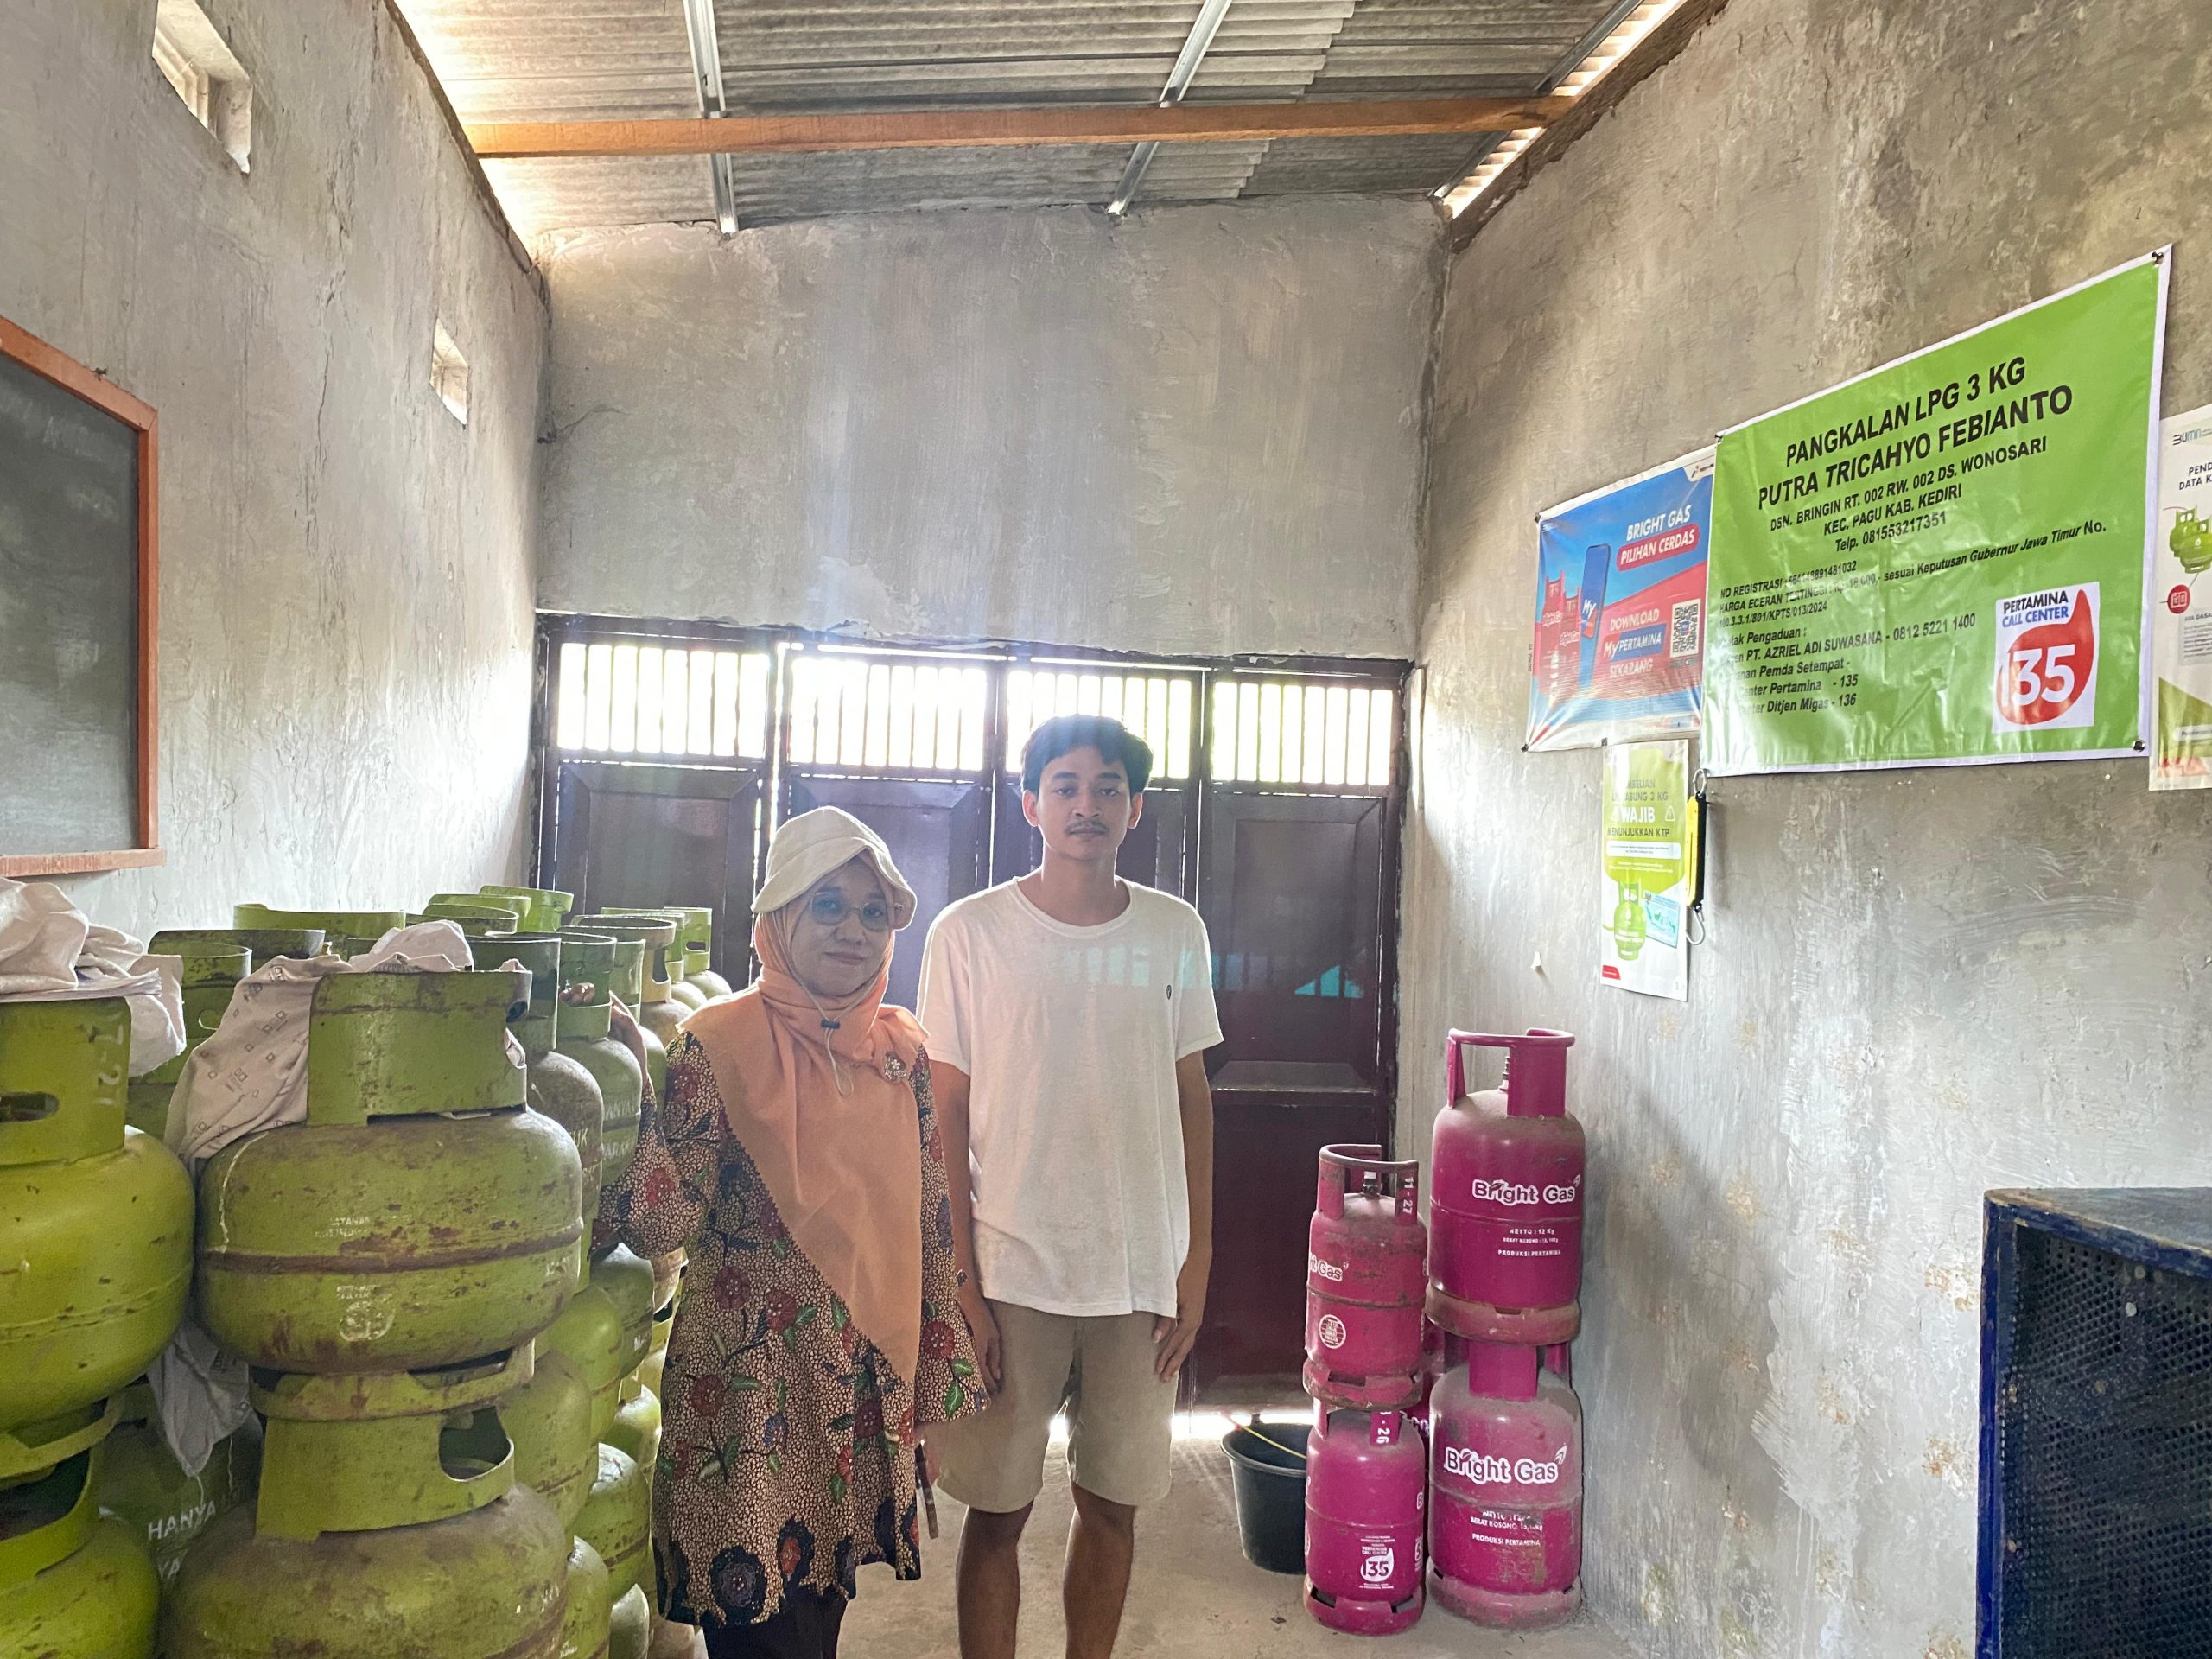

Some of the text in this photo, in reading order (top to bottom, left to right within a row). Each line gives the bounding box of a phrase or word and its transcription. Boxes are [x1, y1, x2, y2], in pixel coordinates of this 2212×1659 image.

[1787, 357, 2025, 467] PANGKALAN LPG 3 KG
[1758, 385, 2072, 510] PUTRA TRICAHYO FEBIANTO
[1770, 436, 2047, 531] DSN. BRINGIN RT. 002 RW. 002 DS. WONOSARI
[2179, 477, 2202, 490] DATA
[1824, 484, 1962, 536] KEC. PAGU KAB. KEDIRI
[1626, 505, 1692, 542] BRIGHT GAS
[1620, 528, 1695, 565] PILIHAN CERDAS
[1835, 537, 1859, 552] Telp.
[1748, 594, 1783, 608] ECERAN
[1884, 568, 1915, 582] sesuai
[1917, 555, 1967, 576] Keputusan
[1969, 543, 2019, 562] Gubernur
[2020, 536, 2048, 550] Jawa
[2051, 526, 2082, 543] Timur
[2083, 520, 2106, 535] No.
[1720, 588, 1731, 599] NO
[1733, 578, 1783, 596] REGISTRASI
[2003, 590, 2069, 615] PERTAMINA
[1610, 608, 1660, 632] DOWNLOAD
[2002, 606, 2069, 628] CALL CENTER
[1746, 627, 1801, 645] Pengaduan
[1746, 649, 1761, 661] PT.
[1764, 645, 1801, 659] AZRIEL
[1804, 641, 1821, 655] ADI
[1824, 631, 1883, 652] SUWASANA
[1893, 625, 1919, 641] 0812
[1923, 619, 1948, 636] 5221
[1952, 613, 1975, 631] 1400
[1759, 663, 1794, 677] Pemda
[1796, 657, 1844, 675] Setempat
[2000, 644, 2075, 707] 135
[1770, 679, 1821, 694] Pertamina
[1840, 674, 1859, 688] 135
[1767, 700, 1796, 715] Ditjen
[1800, 697, 1829, 713] Migas
[1838, 693, 1857, 708] 136
[1623, 792, 1648, 801] ABUNG
[1657, 792, 1669, 801] KG
[1621, 806, 1656, 823] WAJIB
[1656, 829, 1669, 837] KTP
[1472, 1179, 1575, 1206] Bright Gas
[1318, 1260, 1343, 1281] Gas
[1445, 1446, 1558, 1484] Bright Gas
[148, 1500, 216, 1541] HANYA
[1472, 1533, 1503, 1544] PRODUKSI
[1363, 1560, 1389, 1576] 135
